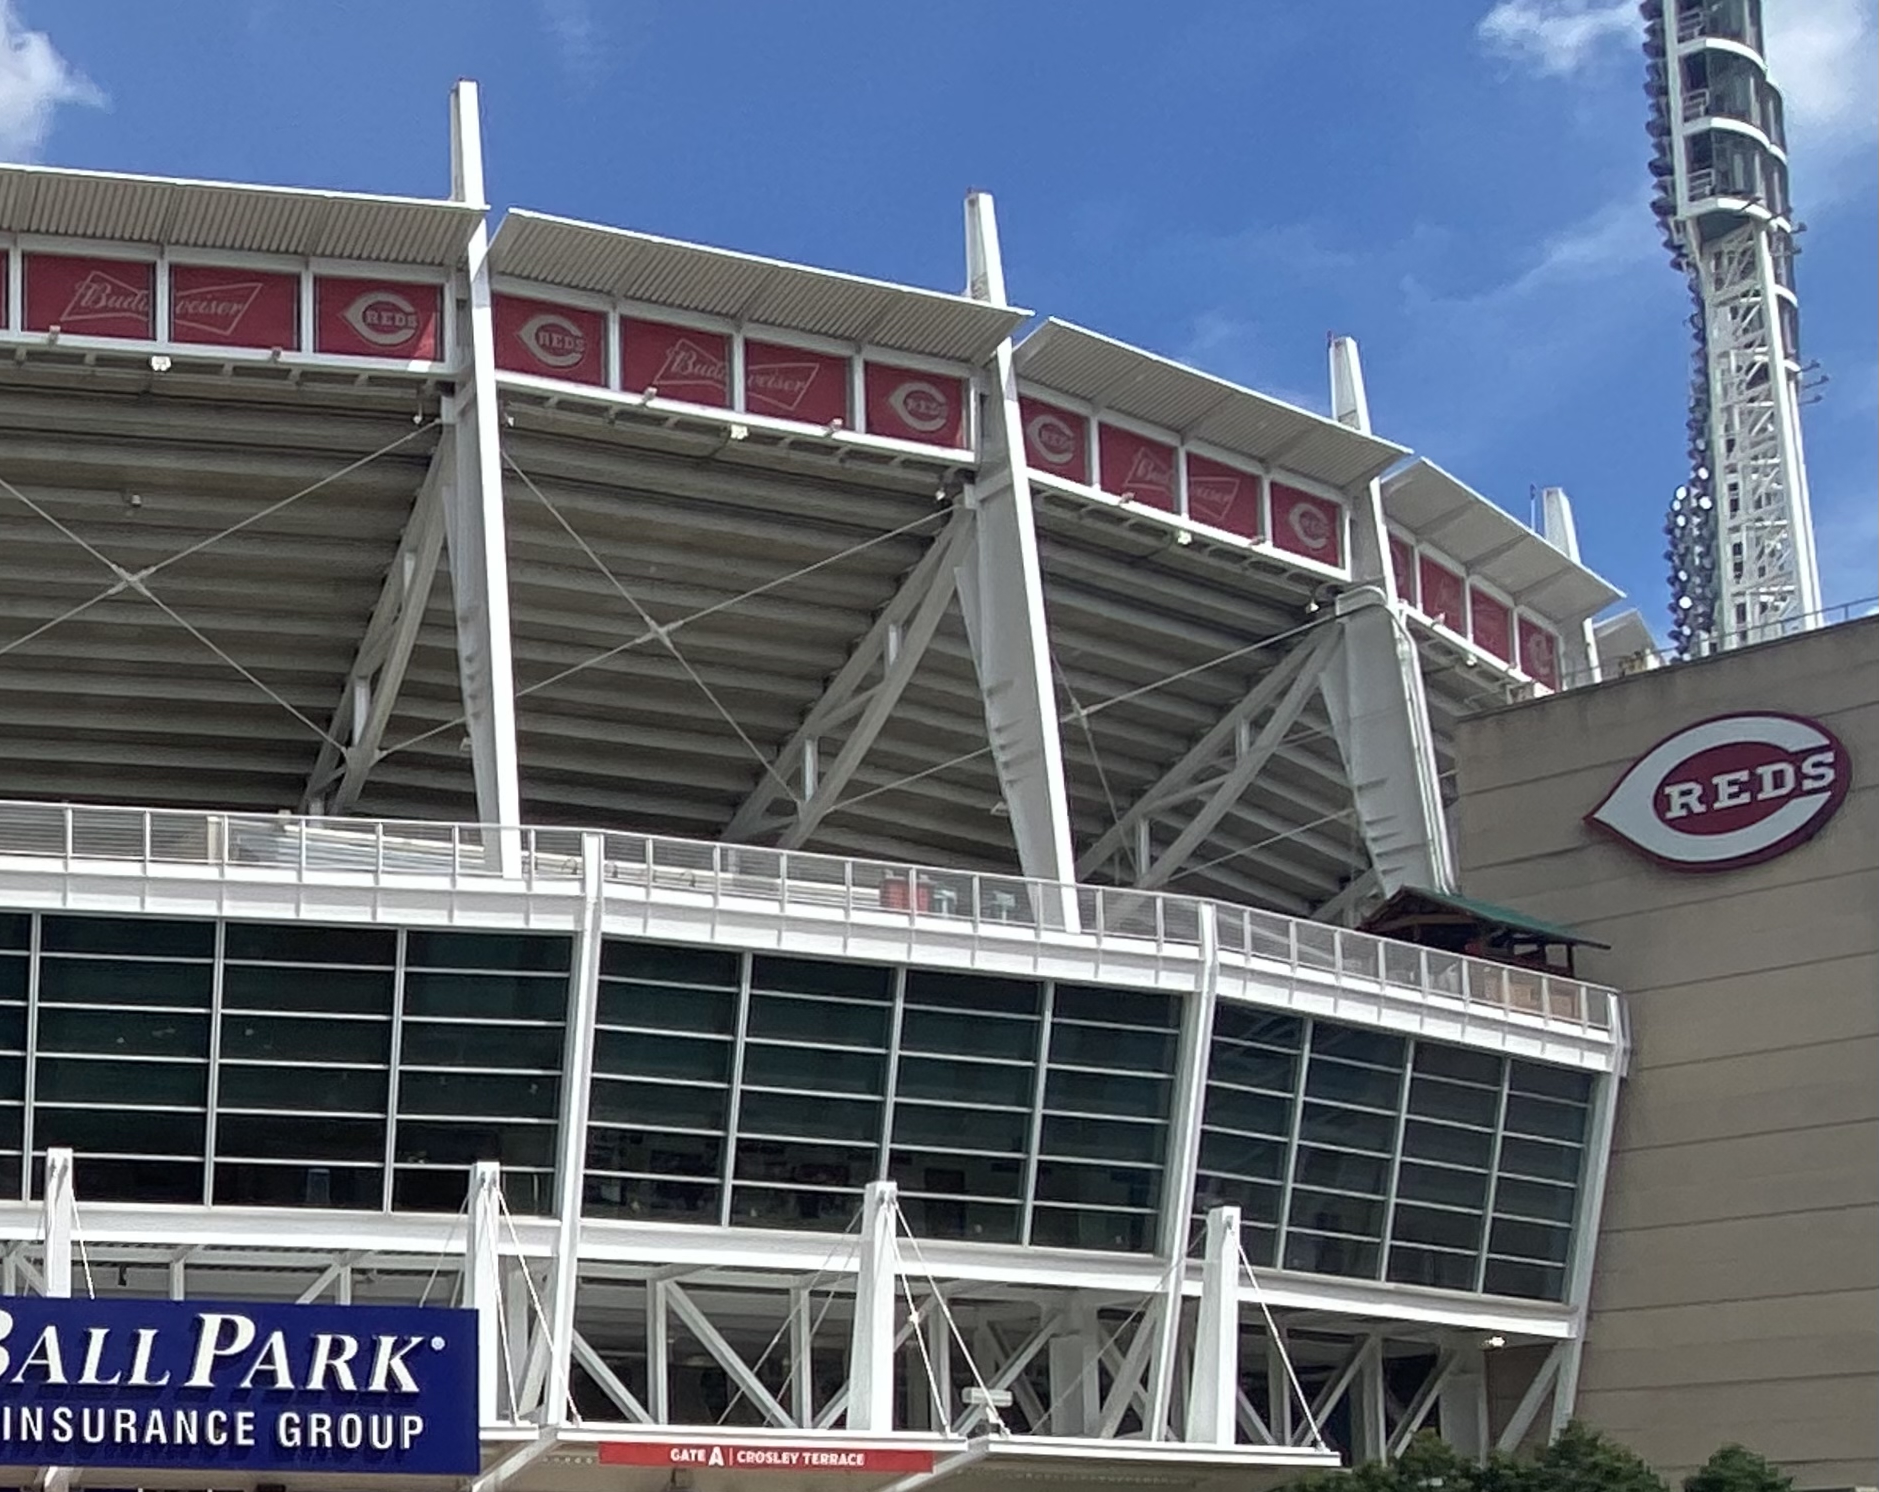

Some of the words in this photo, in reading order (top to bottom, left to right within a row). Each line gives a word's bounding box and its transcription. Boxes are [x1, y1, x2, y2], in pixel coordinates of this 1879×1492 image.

[365, 309, 418, 330] REDS
[538, 332, 586, 353] REDS
[1663, 751, 1836, 820] REDS
[3, 1406, 255, 1446] INSURANCE
[279, 1411, 425, 1449] GROUP
[670, 1448, 706, 1462] GATE
[708, 1446, 724, 1467] A
[736, 1450, 800, 1465] CROSLEY
[803, 1452, 865, 1467] TERRACE
